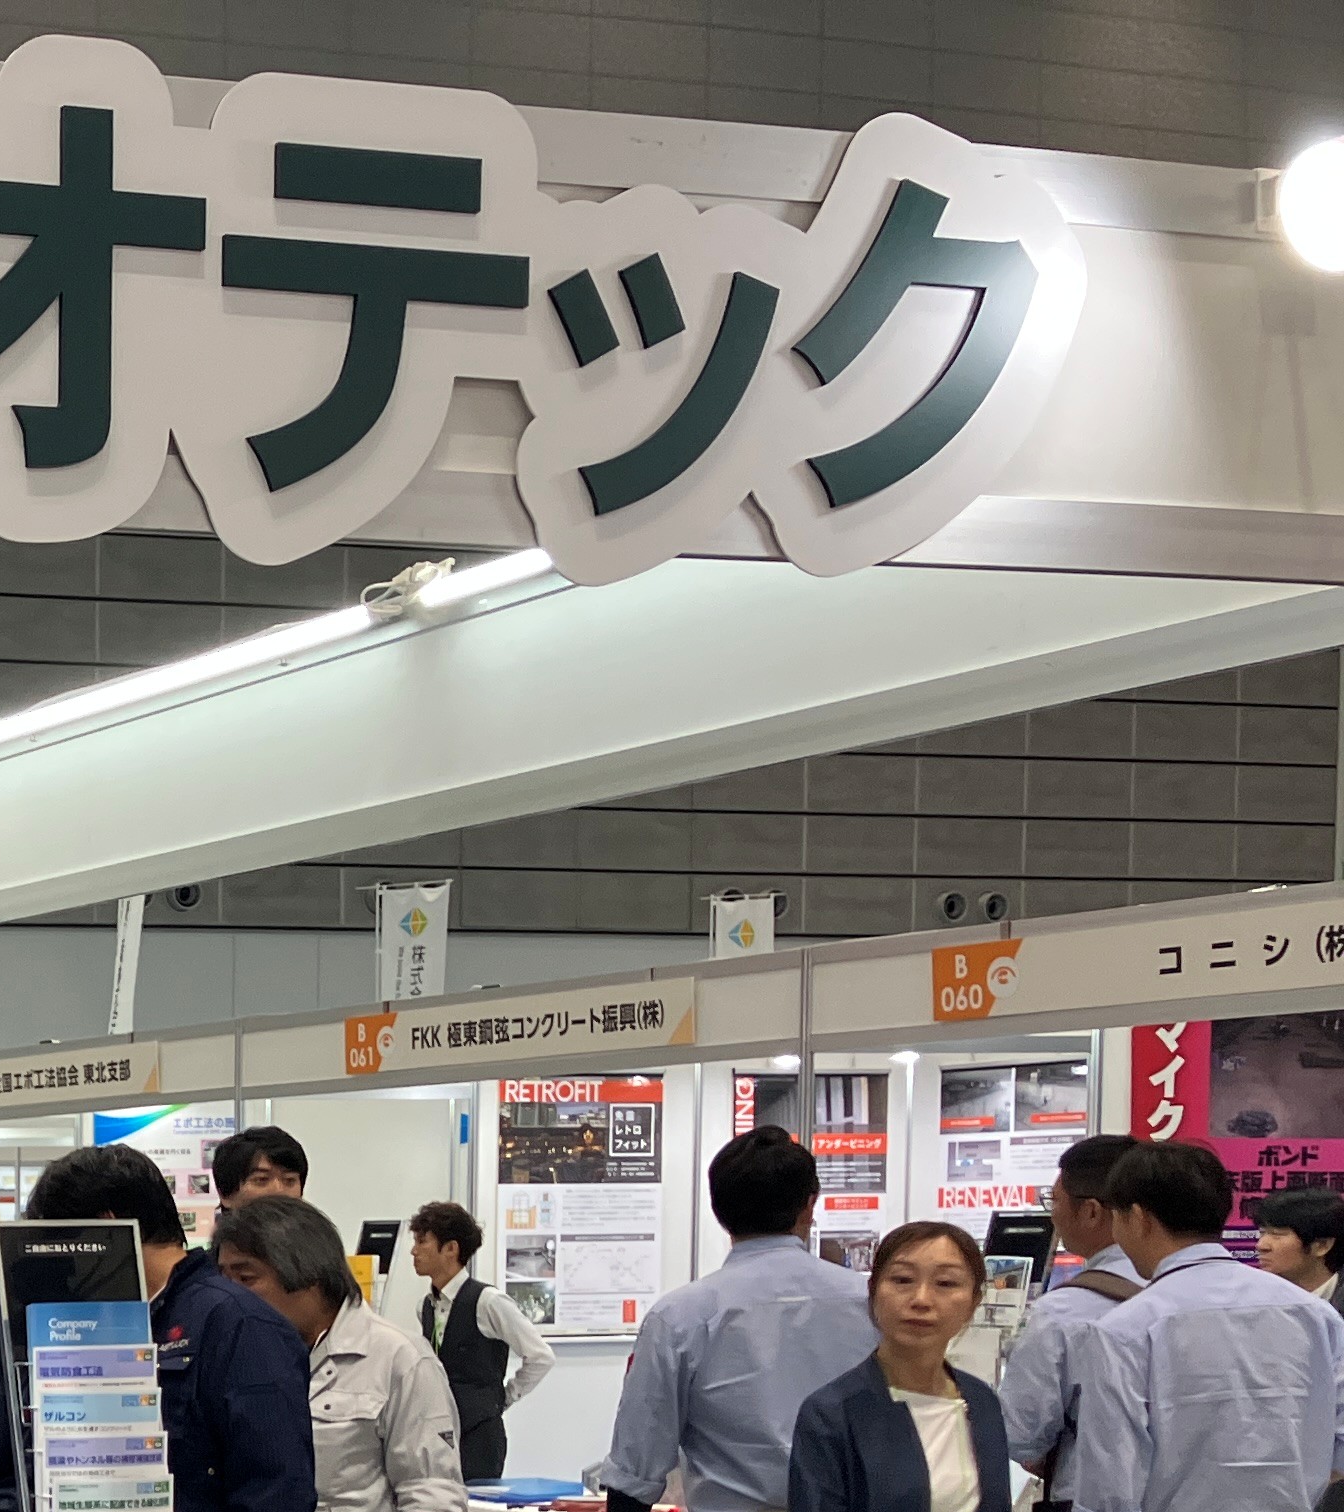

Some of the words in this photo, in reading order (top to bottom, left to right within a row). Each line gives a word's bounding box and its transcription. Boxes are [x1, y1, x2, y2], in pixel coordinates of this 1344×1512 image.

[954, 953, 968, 980] B
[941, 983, 983, 1012] 060
[357, 1023, 366, 1043] B
[411, 1026, 442, 1050] FKK
[447, 998, 665, 1049] 極東鋼弦コンクリート振興(株)
[350, 1046, 374, 1068] 061
[83, 1058, 131, 1085] 東北支部
[505, 1080, 603, 1102] RETROFIT
[615, 1124, 642, 1136] レトロ
[614, 1138, 648, 1150] フィット
[1257, 1145, 1319, 1167] ボンド
[942, 1186, 1030, 1208] RENEWAL
[48, 1318, 98, 1333] Company
[49, 1329, 81, 1342] Profile
[39, 1365, 104, 1378] 電気防食工法
[44, 1411, 87, 1422] ザルコン
